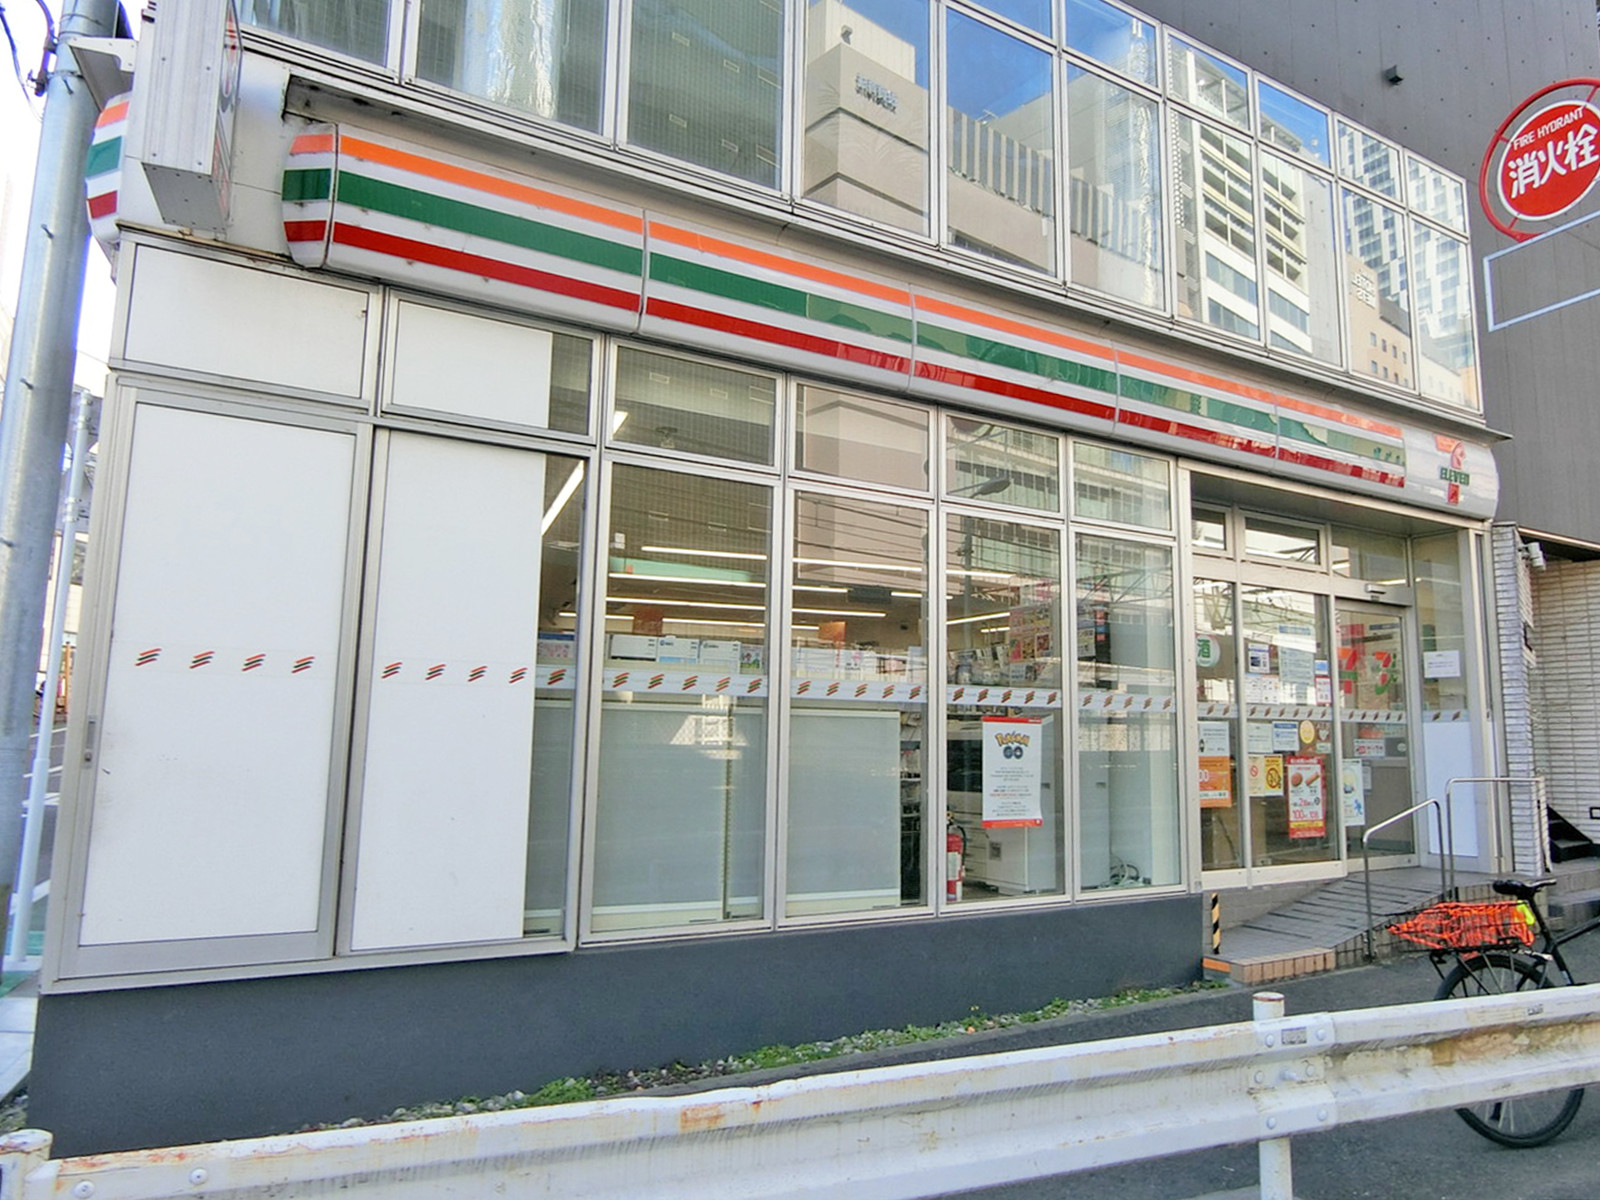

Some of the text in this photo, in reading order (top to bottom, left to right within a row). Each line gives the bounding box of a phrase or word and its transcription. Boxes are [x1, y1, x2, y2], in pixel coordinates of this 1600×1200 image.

[1513, 107, 1584, 150] FIRE HYDRANT
[1508, 123, 1600, 199] 消火栓
[1003, 745, 1024, 760] GO
